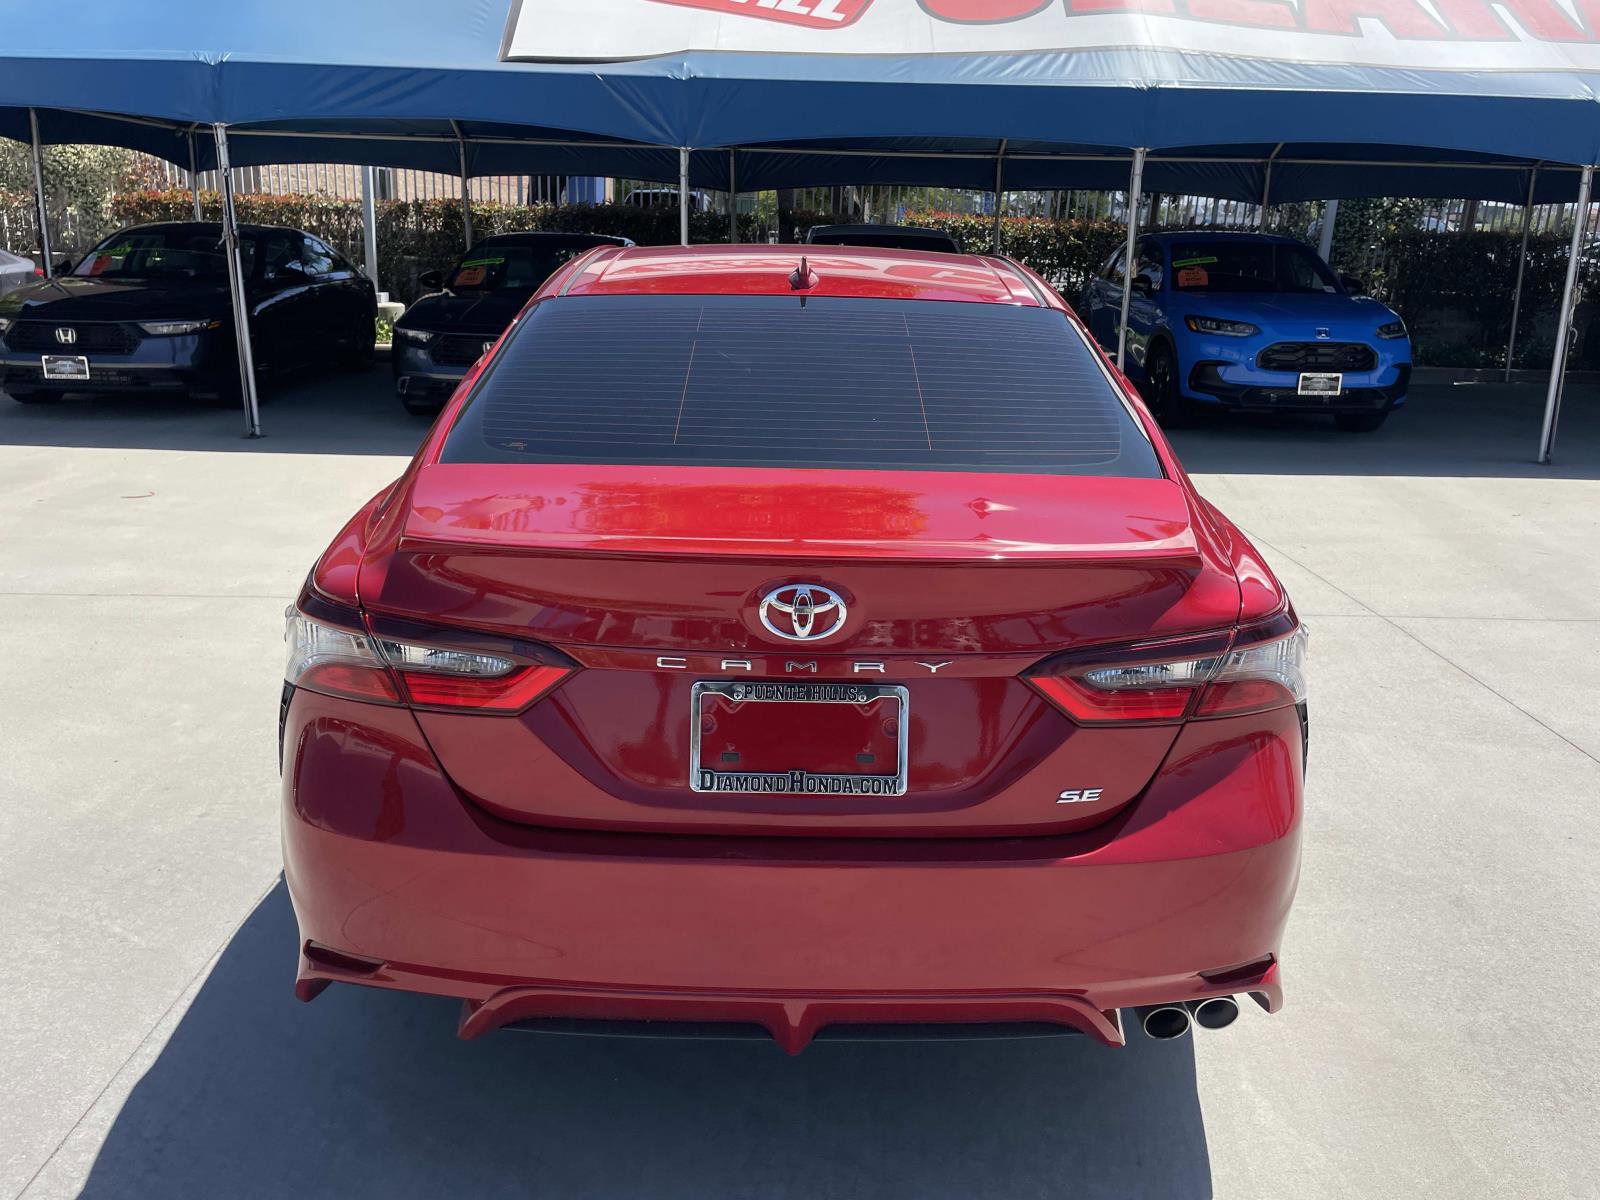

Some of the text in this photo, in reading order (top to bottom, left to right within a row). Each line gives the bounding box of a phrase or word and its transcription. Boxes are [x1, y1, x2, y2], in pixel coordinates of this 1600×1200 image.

[656, 656, 953, 673] CAMRY
[743, 684, 859, 702] PUENTE HILLS
[1056, 788, 1104, 804] SE
